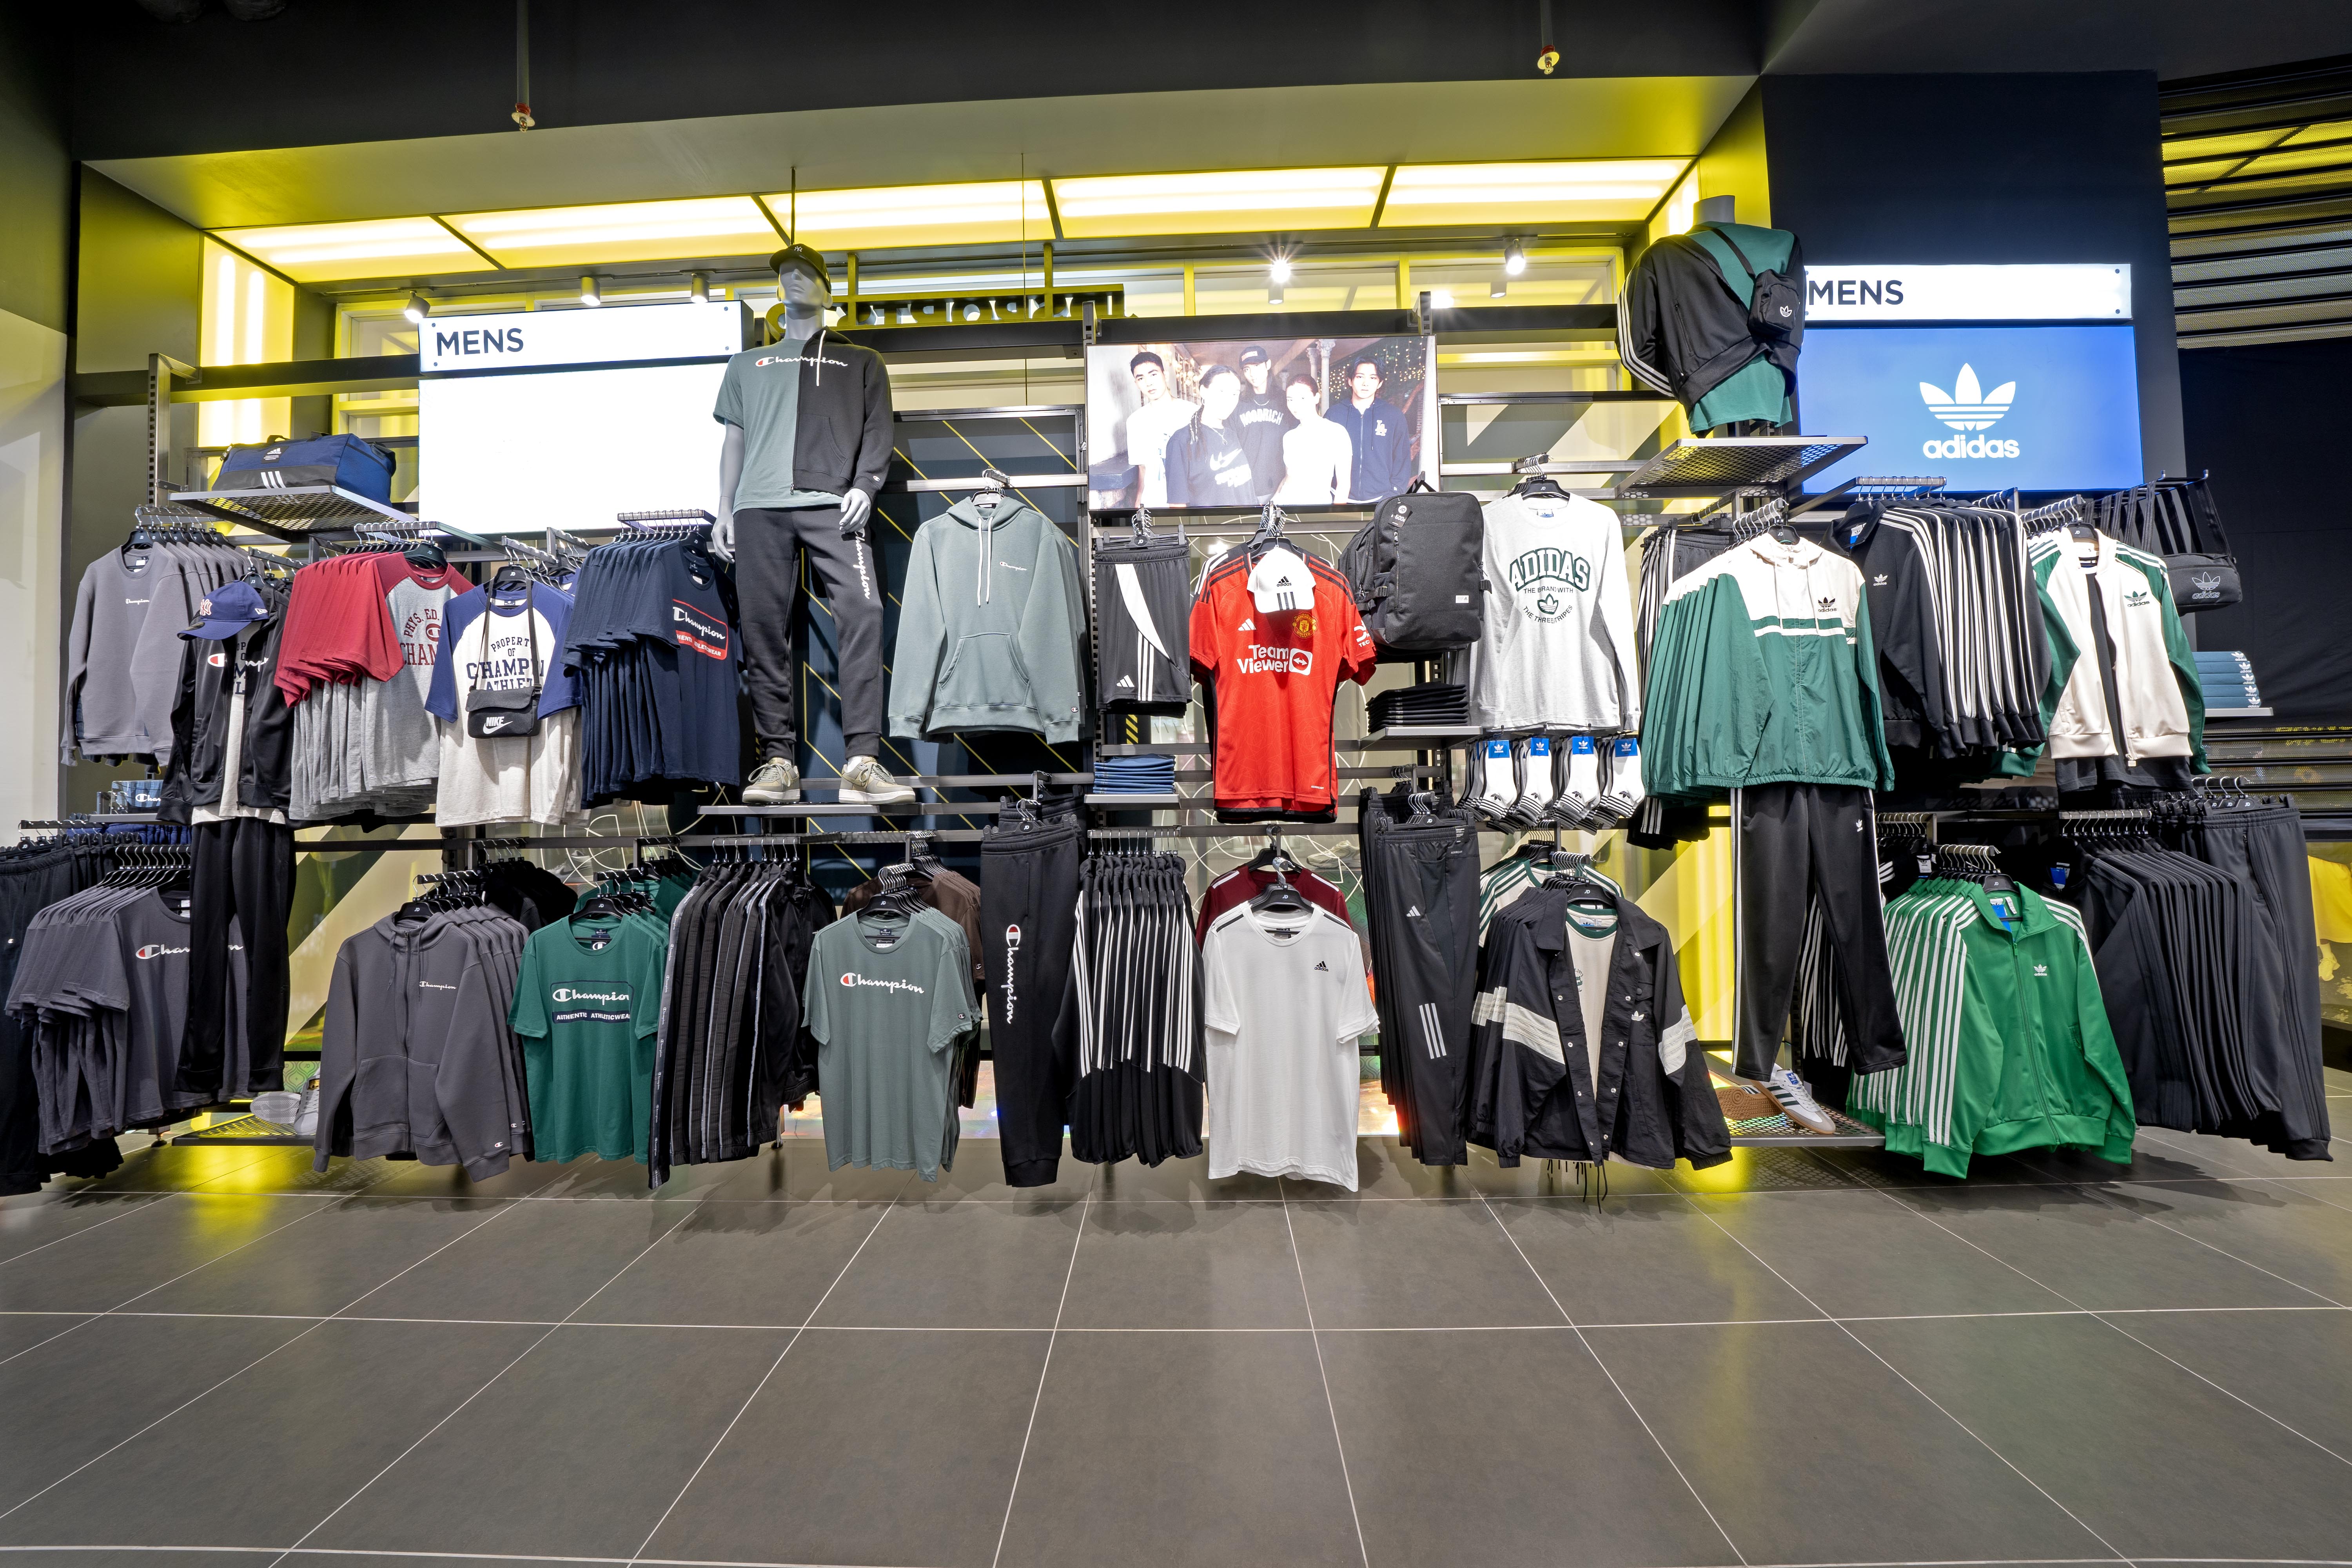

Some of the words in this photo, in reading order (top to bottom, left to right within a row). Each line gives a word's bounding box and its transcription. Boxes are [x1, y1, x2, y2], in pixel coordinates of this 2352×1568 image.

[1809, 280, 1904, 305] MENS
[436, 328, 524, 356] MENS
[755, 355, 848, 367] Champion
[1923, 434, 2020, 459] adidas
[1000, 561, 1027, 571] Champion
[1510, 547, 1591, 592] ADIDAS
[1523, 605, 1534, 619] THE
[404, 613, 424, 638] PHYS.
[424, 609, 439, 621] ED.
[673, 606, 726, 640] Champion
[491, 637, 530, 652] PROPERT
[508, 648, 516, 657] OF
[1248, 644, 1289, 660] Team
[1237, 658, 1289, 674] Viewer
[486, 717, 505, 727] NIKE
[1001, 924, 1021, 1024] Champion
[419, 981, 457, 991] Champion
[840, 972, 925, 994] Champion
[556, 1012, 588, 1020] AUTHENTIC
